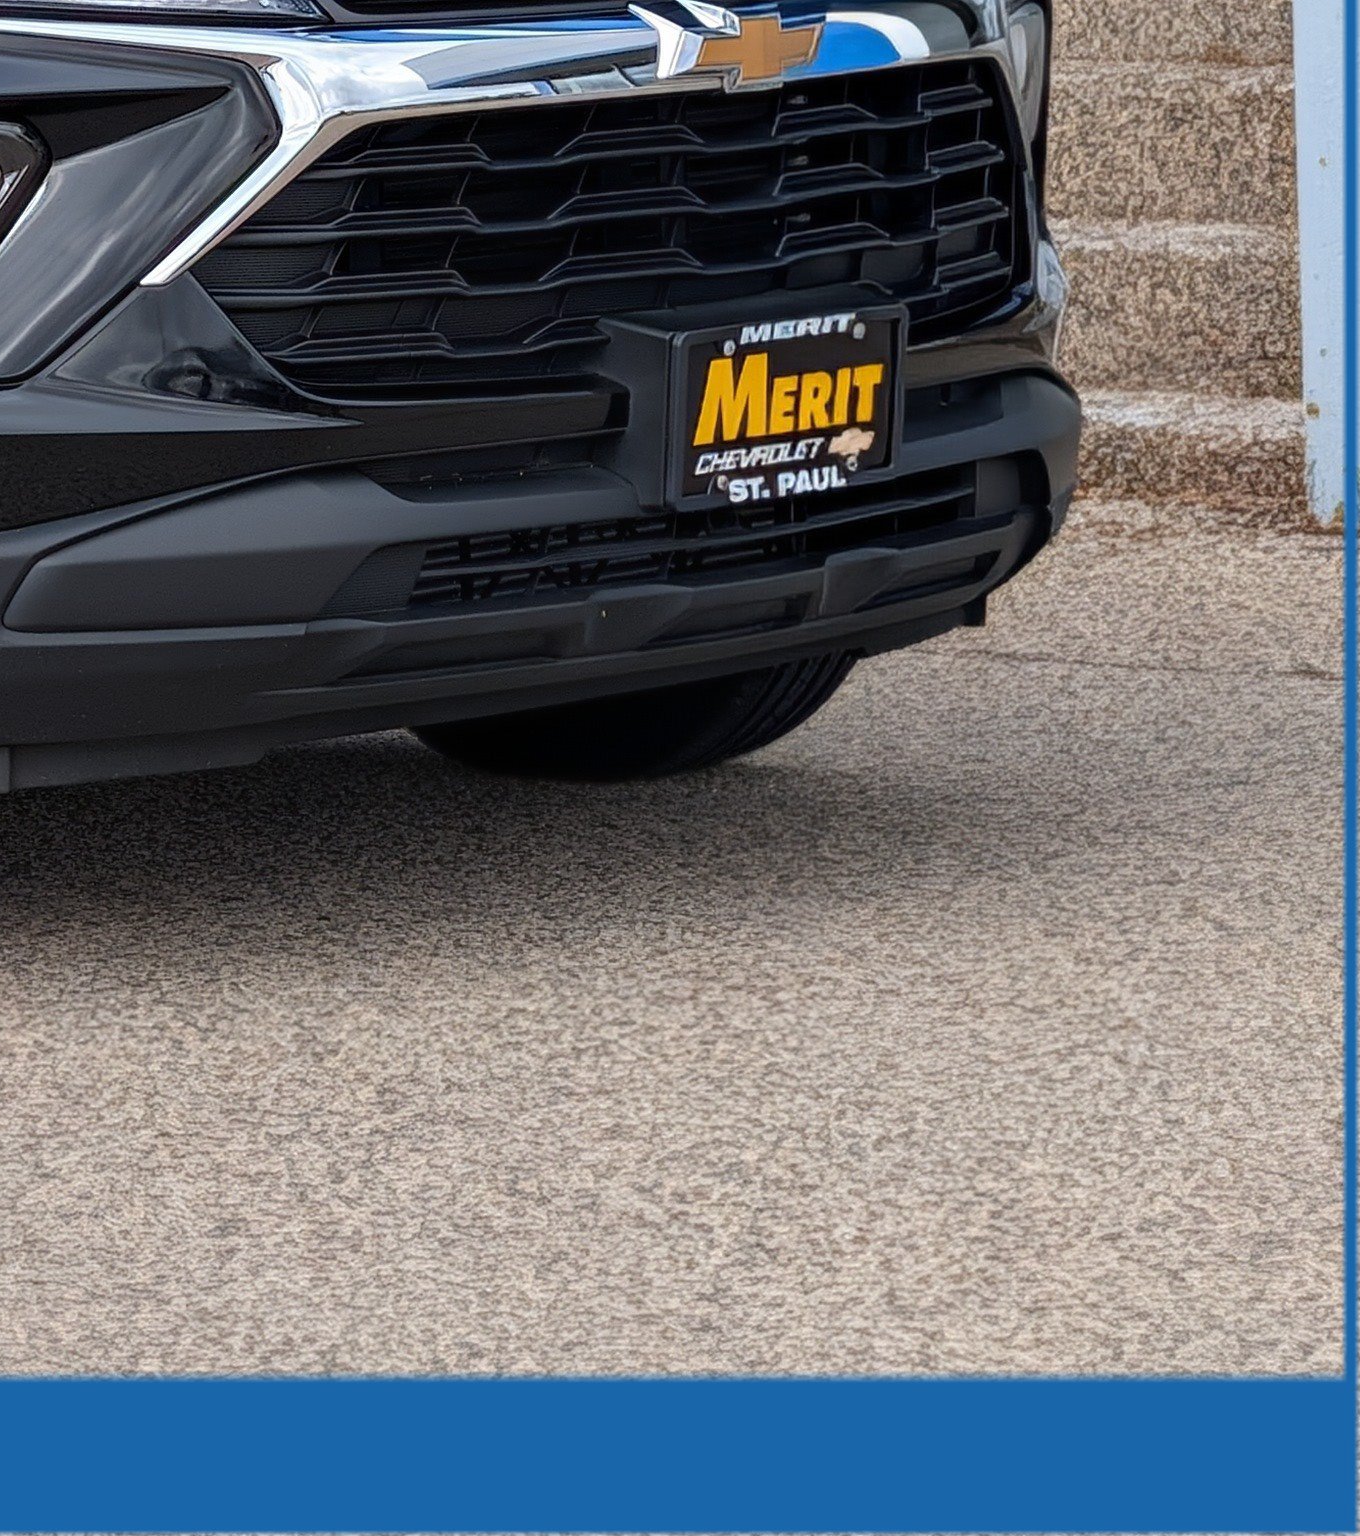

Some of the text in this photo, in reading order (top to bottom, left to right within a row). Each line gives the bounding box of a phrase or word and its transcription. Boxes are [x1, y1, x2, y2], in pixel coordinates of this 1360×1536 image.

[740, 313, 856, 345] MERIT
[694, 353, 884, 446] MERIT
[694, 436, 825, 476] CHEVROLET
[728, 464, 848, 503] ST. PAUL
